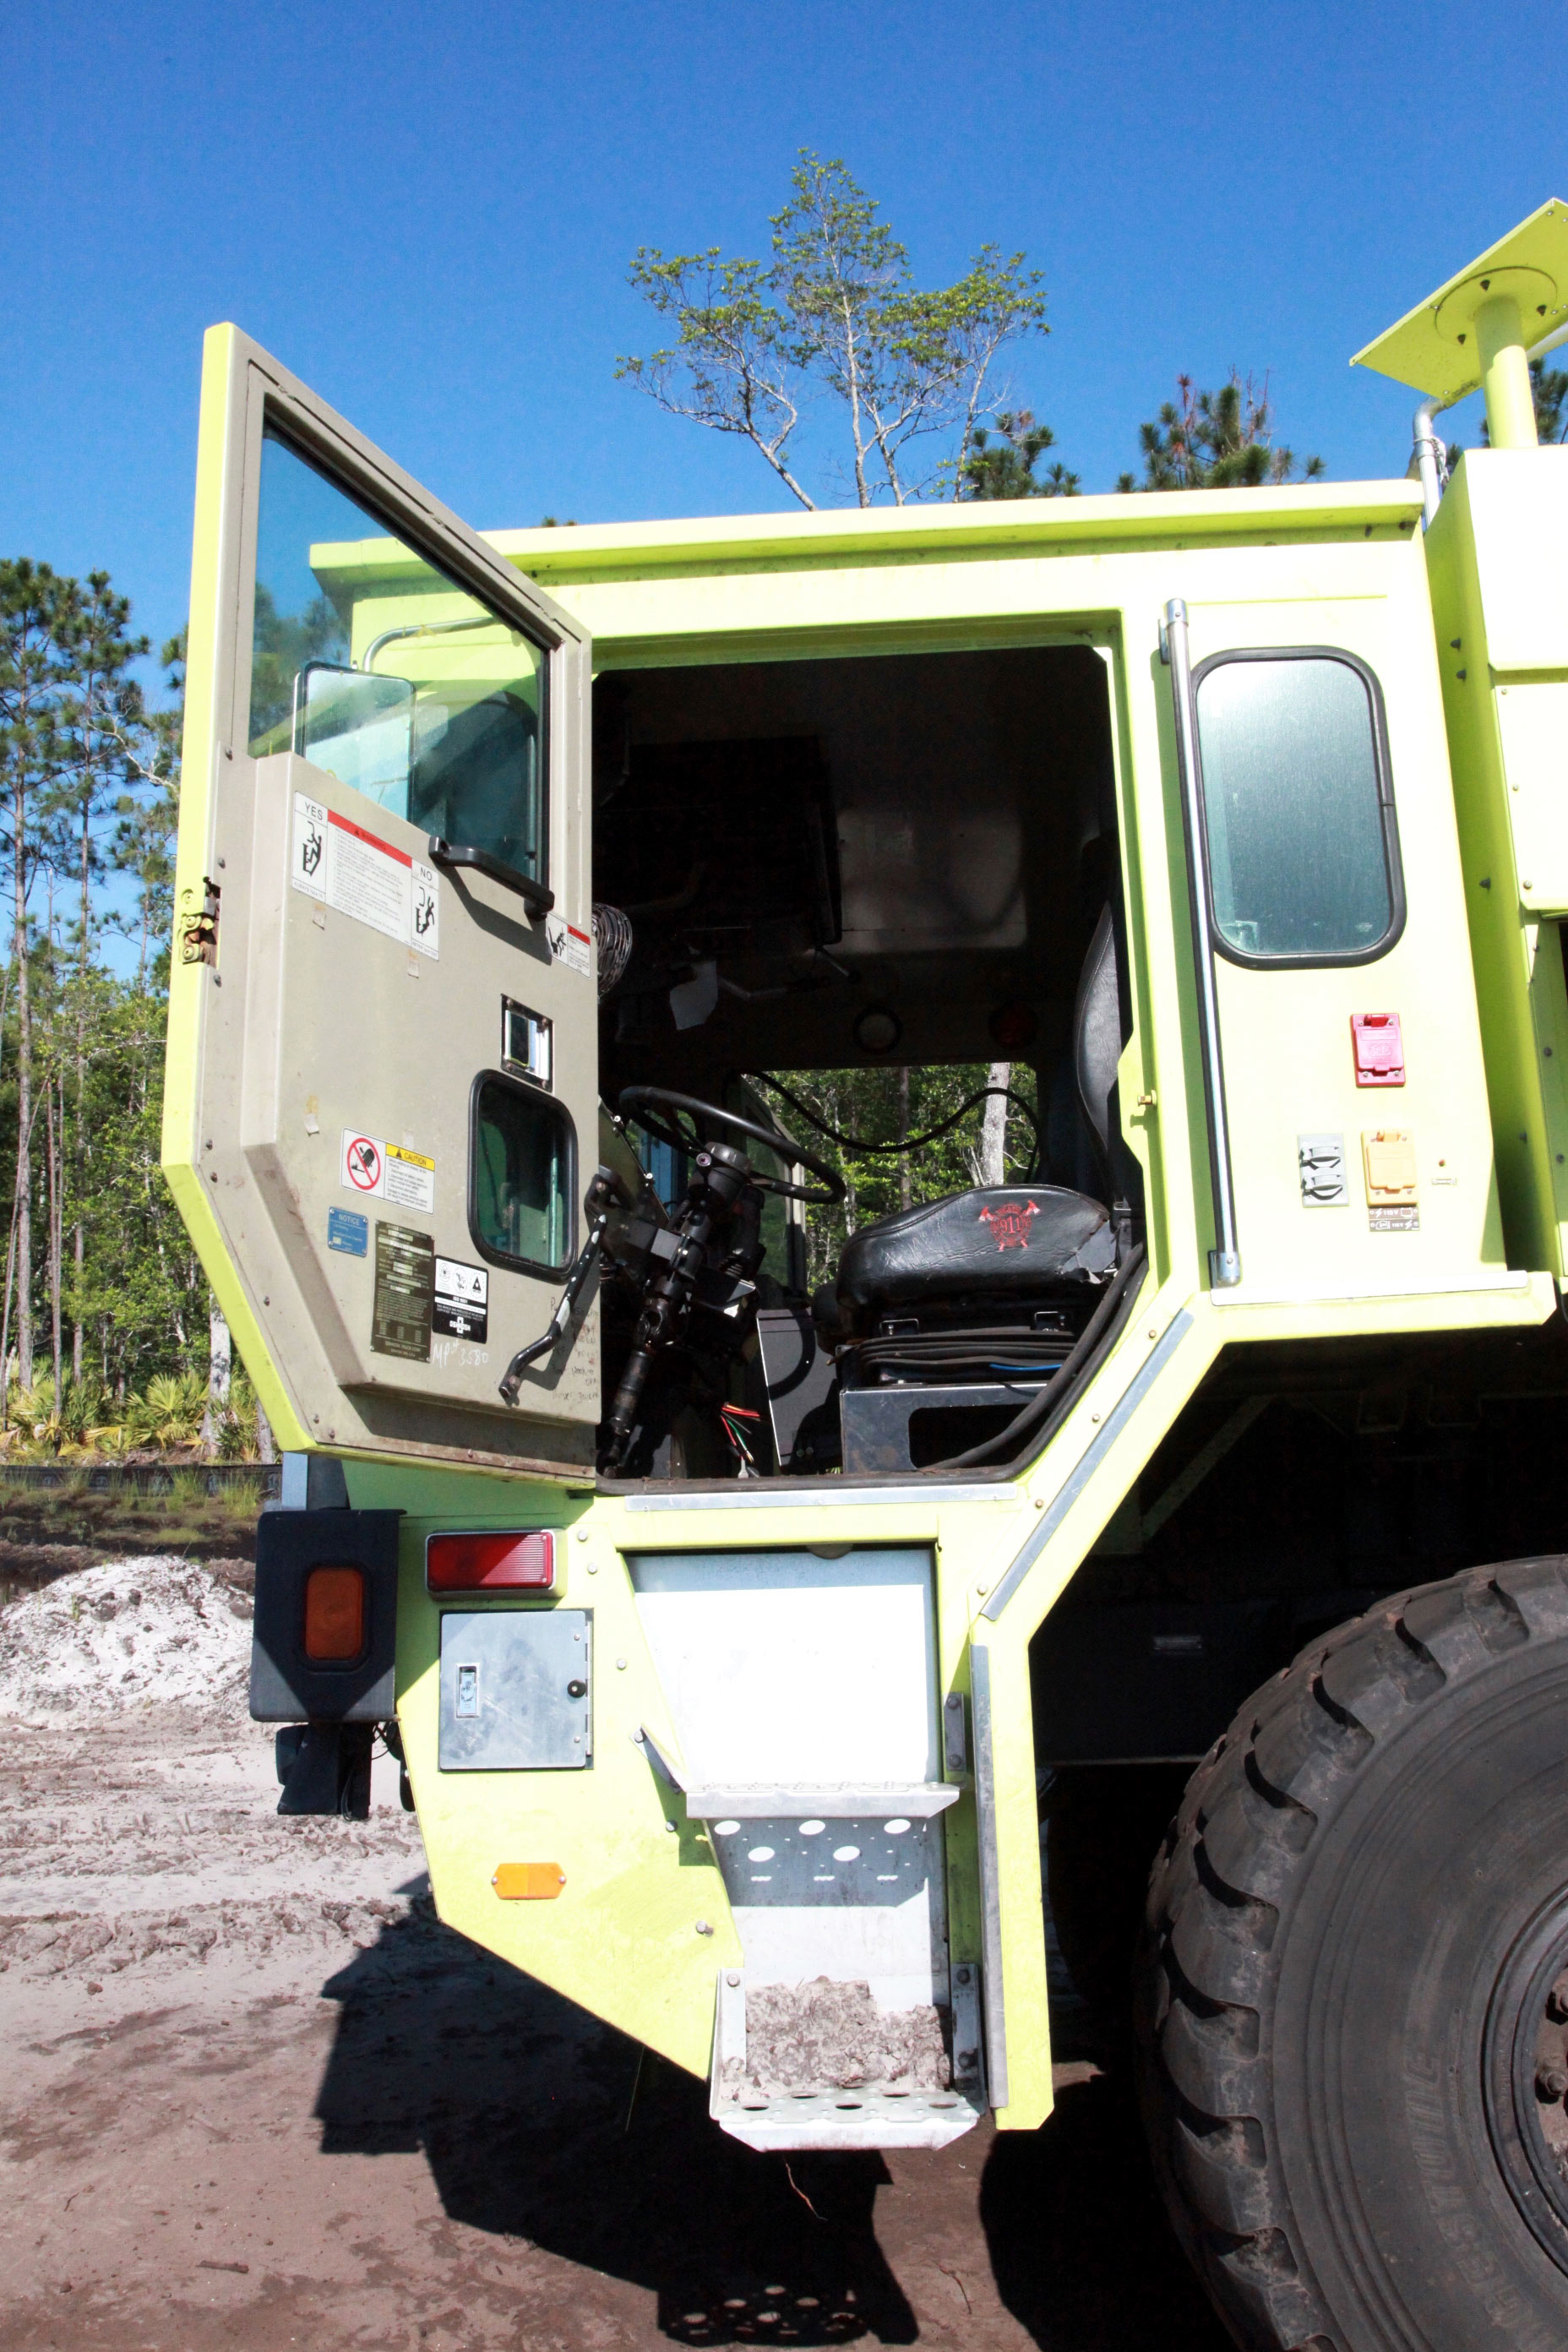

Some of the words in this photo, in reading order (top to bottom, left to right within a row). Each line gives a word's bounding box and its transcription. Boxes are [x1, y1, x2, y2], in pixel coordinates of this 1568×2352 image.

[305, 802, 323, 820] YES
[420, 867, 433, 881] NO
[404, 1152, 427, 1166] CAUTION
[339, 1213, 360, 1226] NOTICE
[999, 1216, 1021, 1233] 911
